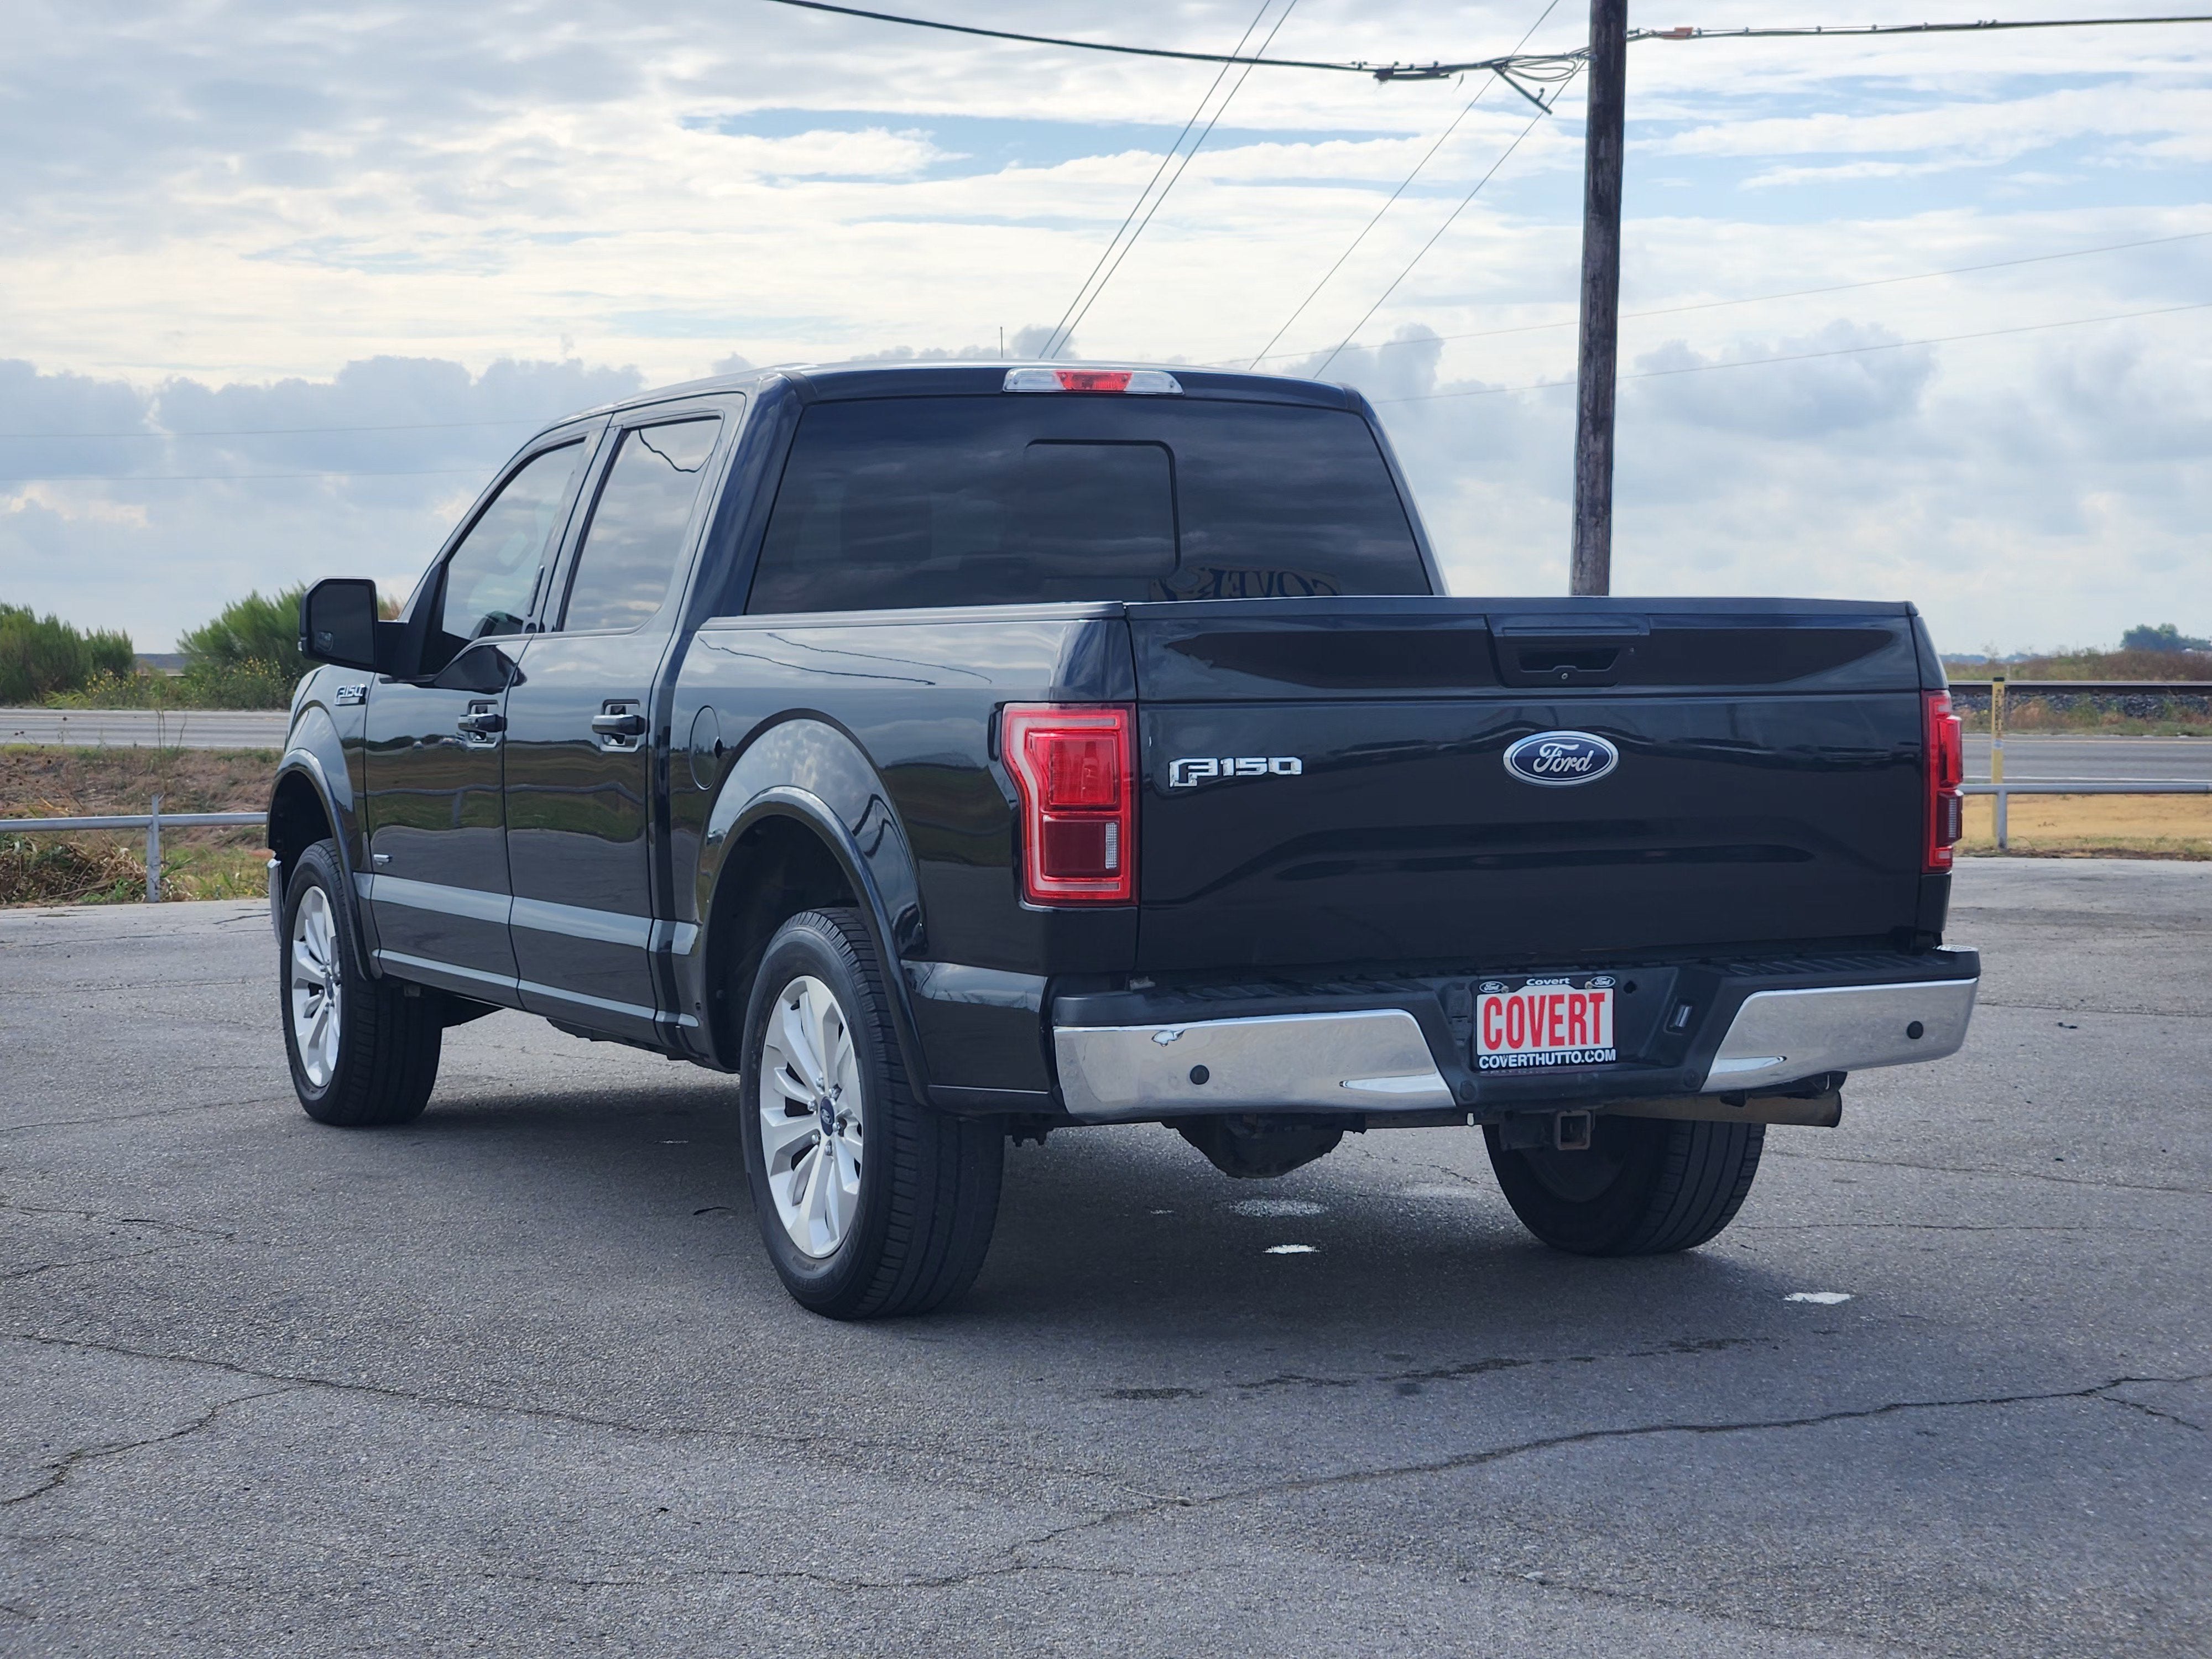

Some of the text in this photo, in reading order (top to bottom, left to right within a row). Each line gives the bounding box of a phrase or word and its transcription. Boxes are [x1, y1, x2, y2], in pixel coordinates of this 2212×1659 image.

[1533, 743, 1594, 773] Ford
[1526, 977, 1571, 986] Covert
[1483, 993, 1605, 1050] COVERT
[1479, 1049, 1616, 1069] COVERTHUTTO.COM
